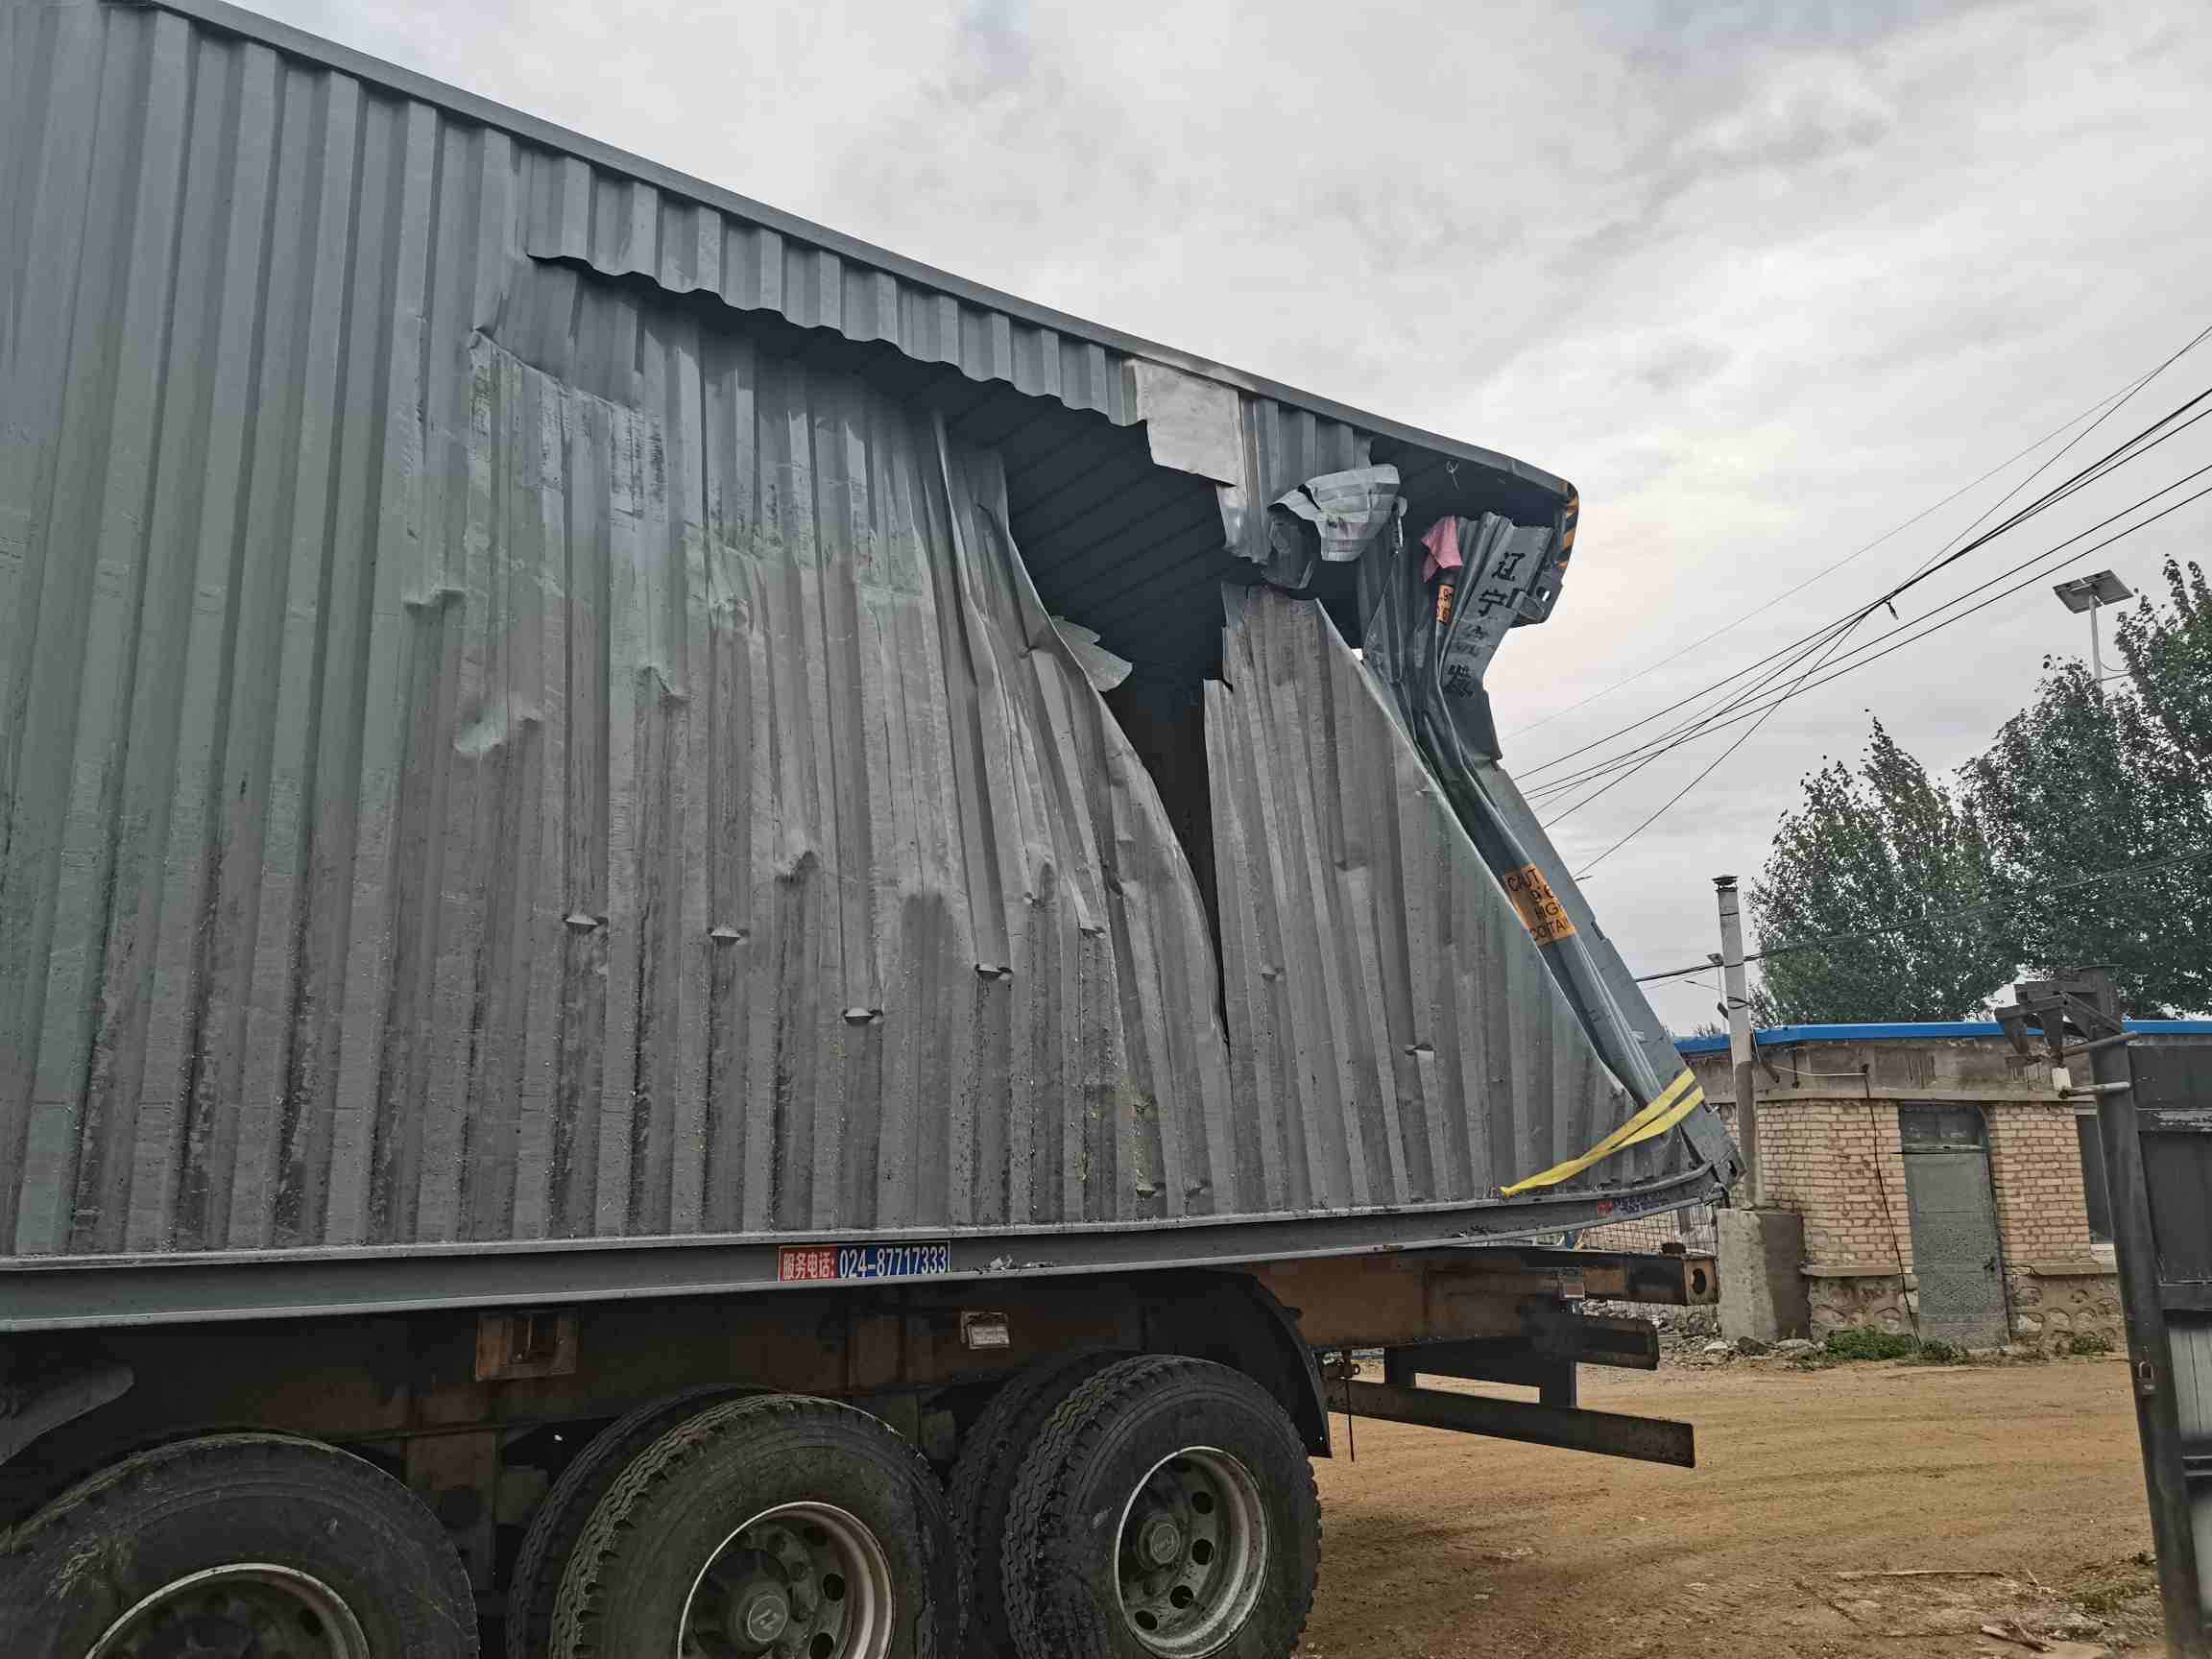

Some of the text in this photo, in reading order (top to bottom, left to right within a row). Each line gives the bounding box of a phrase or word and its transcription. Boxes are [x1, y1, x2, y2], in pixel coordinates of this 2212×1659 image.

[783, 1245, 947, 1281] 服务电话: 024-87717333
